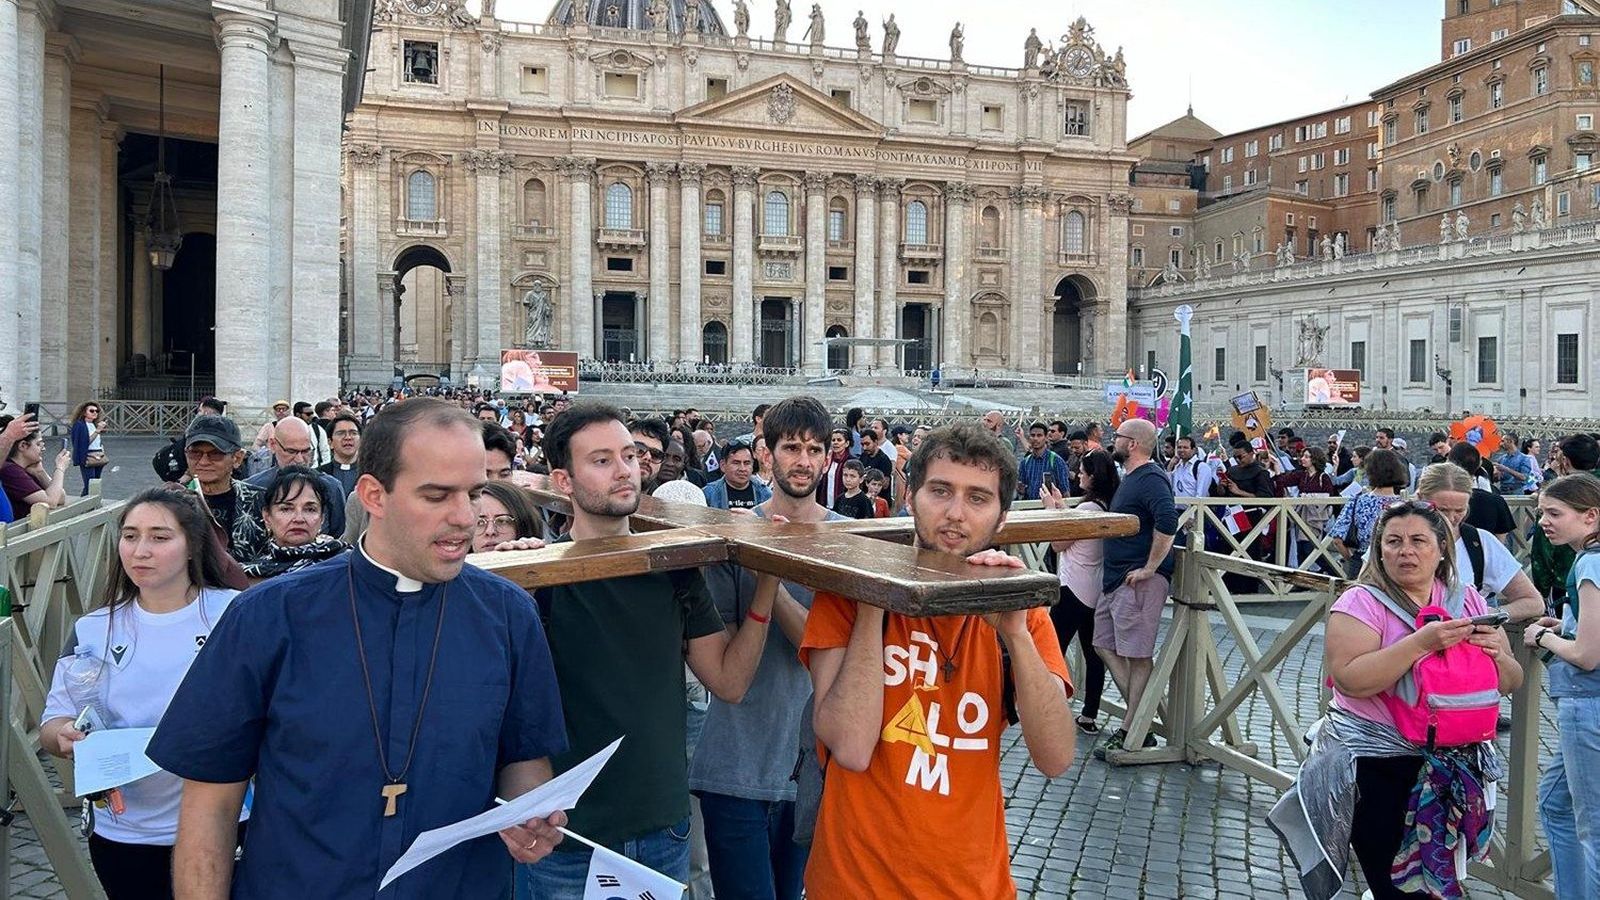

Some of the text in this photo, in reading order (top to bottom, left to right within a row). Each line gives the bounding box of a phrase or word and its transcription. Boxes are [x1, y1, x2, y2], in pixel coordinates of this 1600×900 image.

[478, 121, 494, 132] IN
[500, 124, 568, 139] HONOREM
[816, 145, 875, 158] ROMANVS
